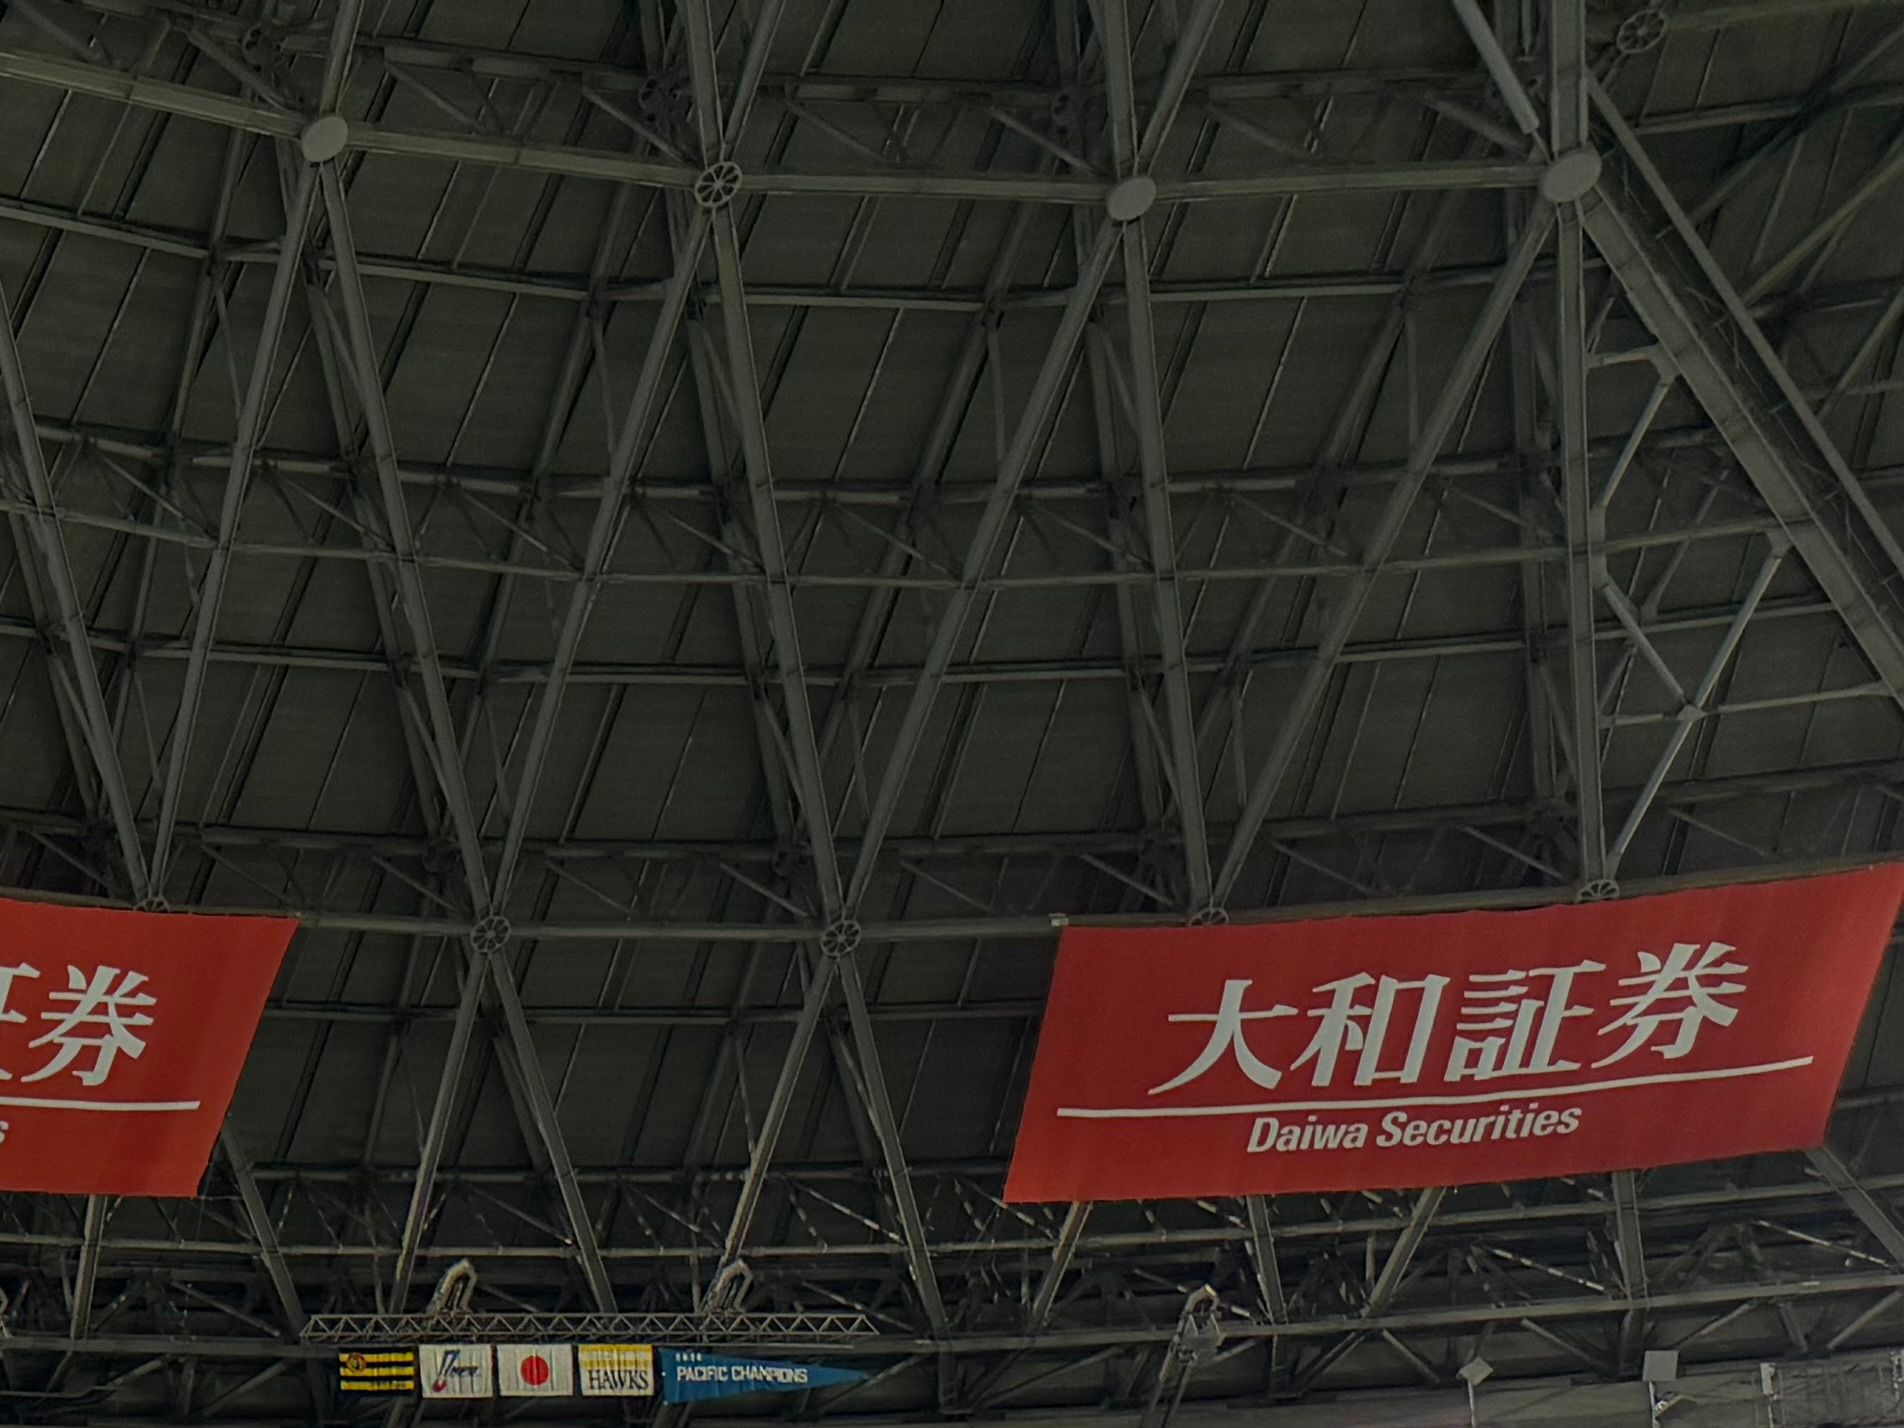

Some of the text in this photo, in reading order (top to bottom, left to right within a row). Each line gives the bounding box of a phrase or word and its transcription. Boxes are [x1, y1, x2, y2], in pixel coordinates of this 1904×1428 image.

[1148, 941, 1750, 1096] 大和証券
[1247, 1101, 1583, 1155] Daiwa Securities
[587, 1368, 650, 1392] HAWKS
